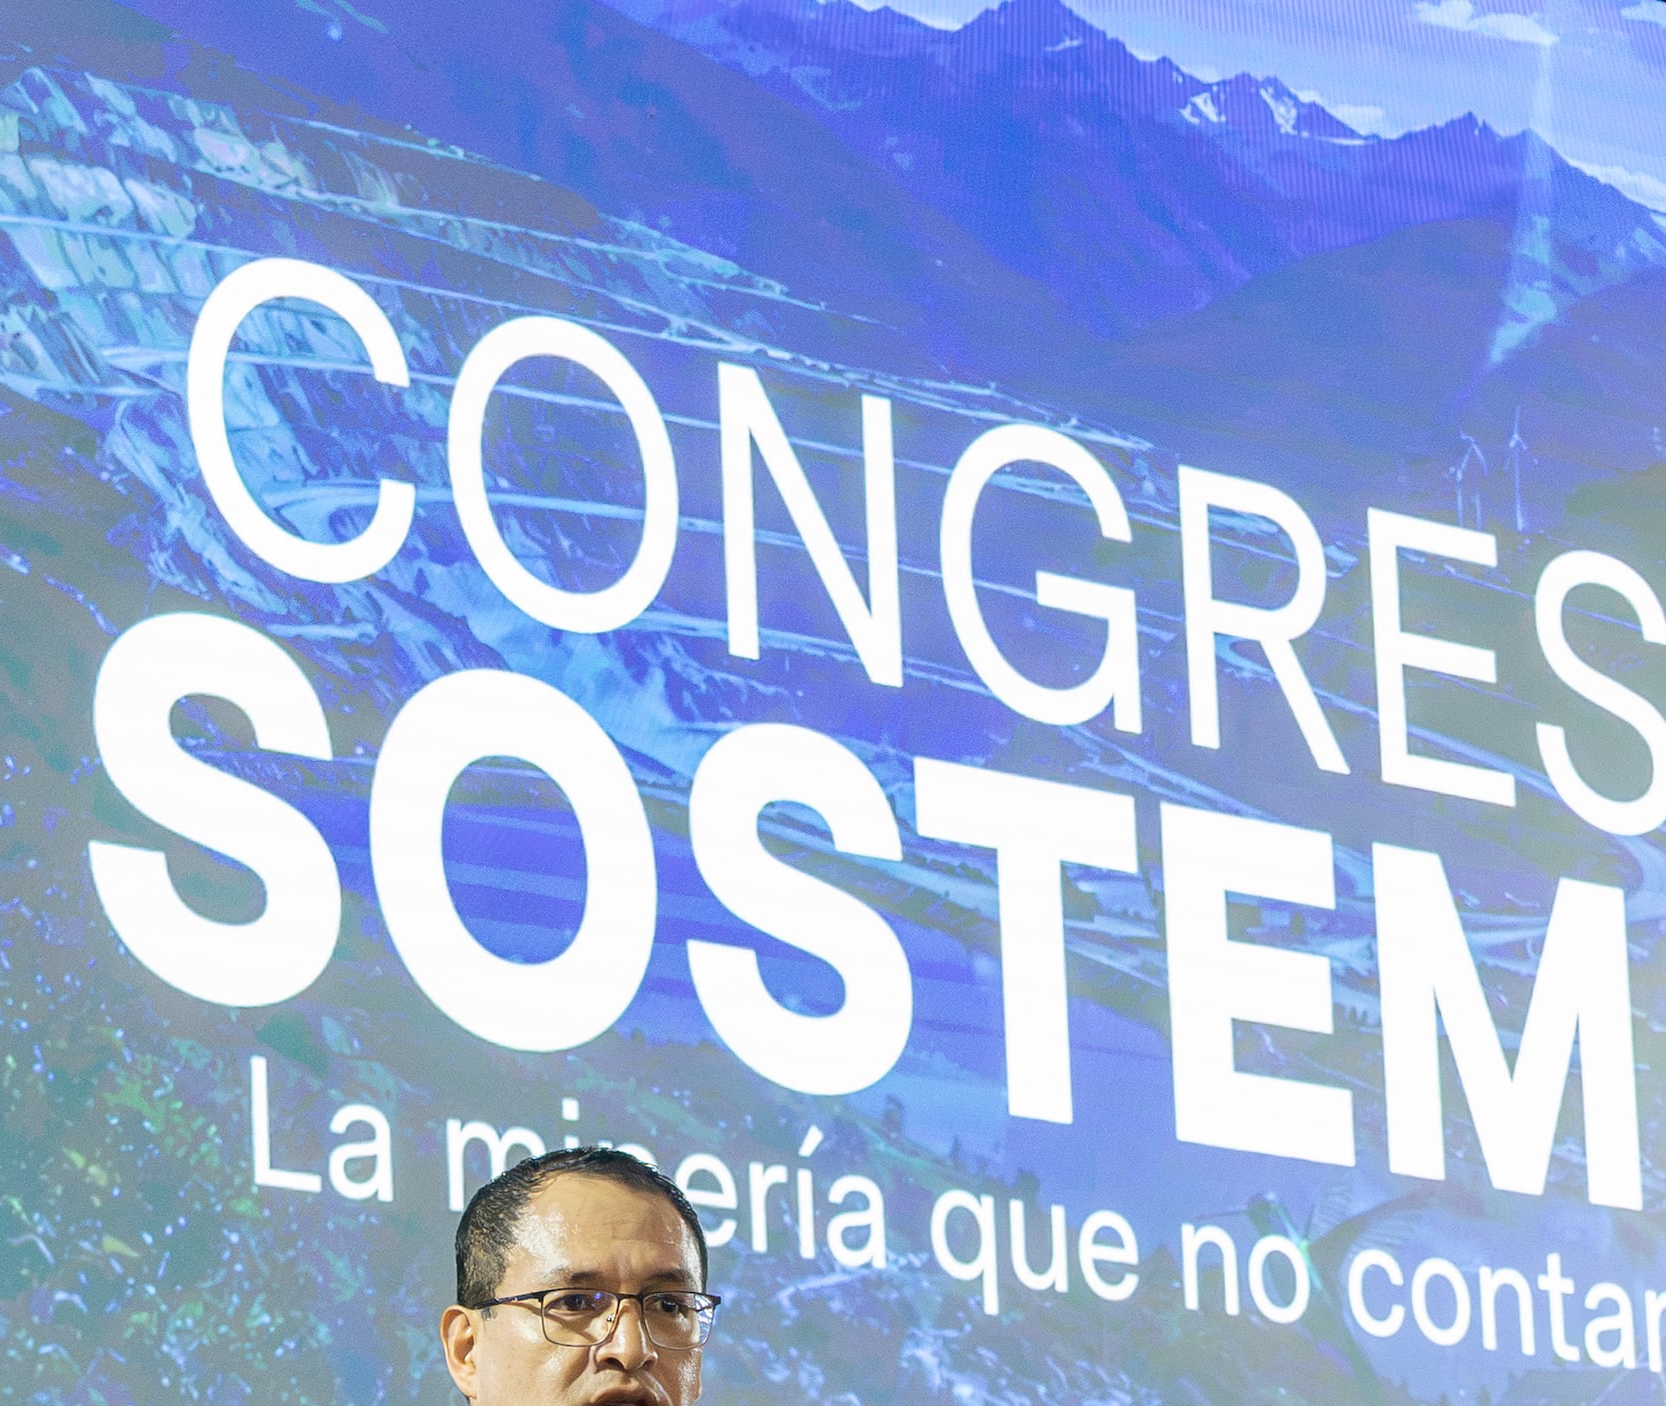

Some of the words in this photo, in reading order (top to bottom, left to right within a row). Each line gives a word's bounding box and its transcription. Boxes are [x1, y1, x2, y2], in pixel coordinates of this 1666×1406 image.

[250, 1055, 395, 1203] La
[445, 1098, 888, 1271] mería
[930, 1188, 1141, 1317] que
[1180, 1223, 1310, 1326] no
